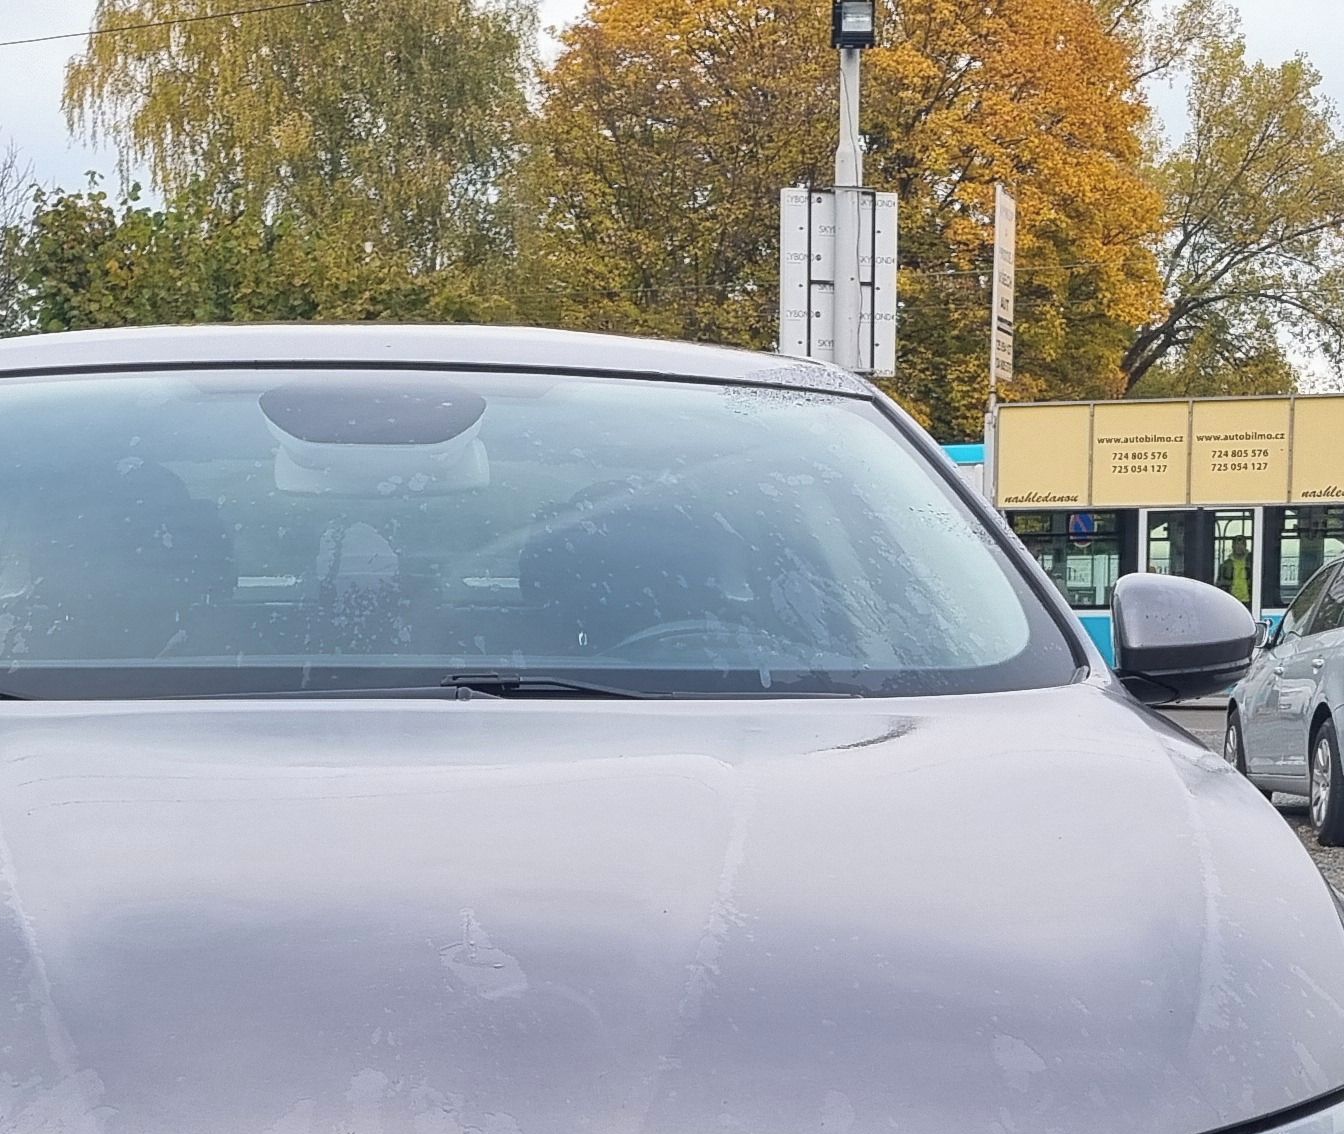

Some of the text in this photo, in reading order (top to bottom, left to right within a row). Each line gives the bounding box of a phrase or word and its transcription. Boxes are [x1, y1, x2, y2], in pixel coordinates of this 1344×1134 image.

[1097, 434, 1184, 444] www.autobilmo.cz
[1196, 432, 1286, 442] www.autobilmo.cz
[1111, 451, 1168, 461] 724 805 576
[1211, 449, 1269, 459] 724 805 576
[1111, 464, 1168, 474] 725 054 127
[1211, 462, 1268, 472] 725 054 127
[1004, 491, 1079, 504] nashledanou
